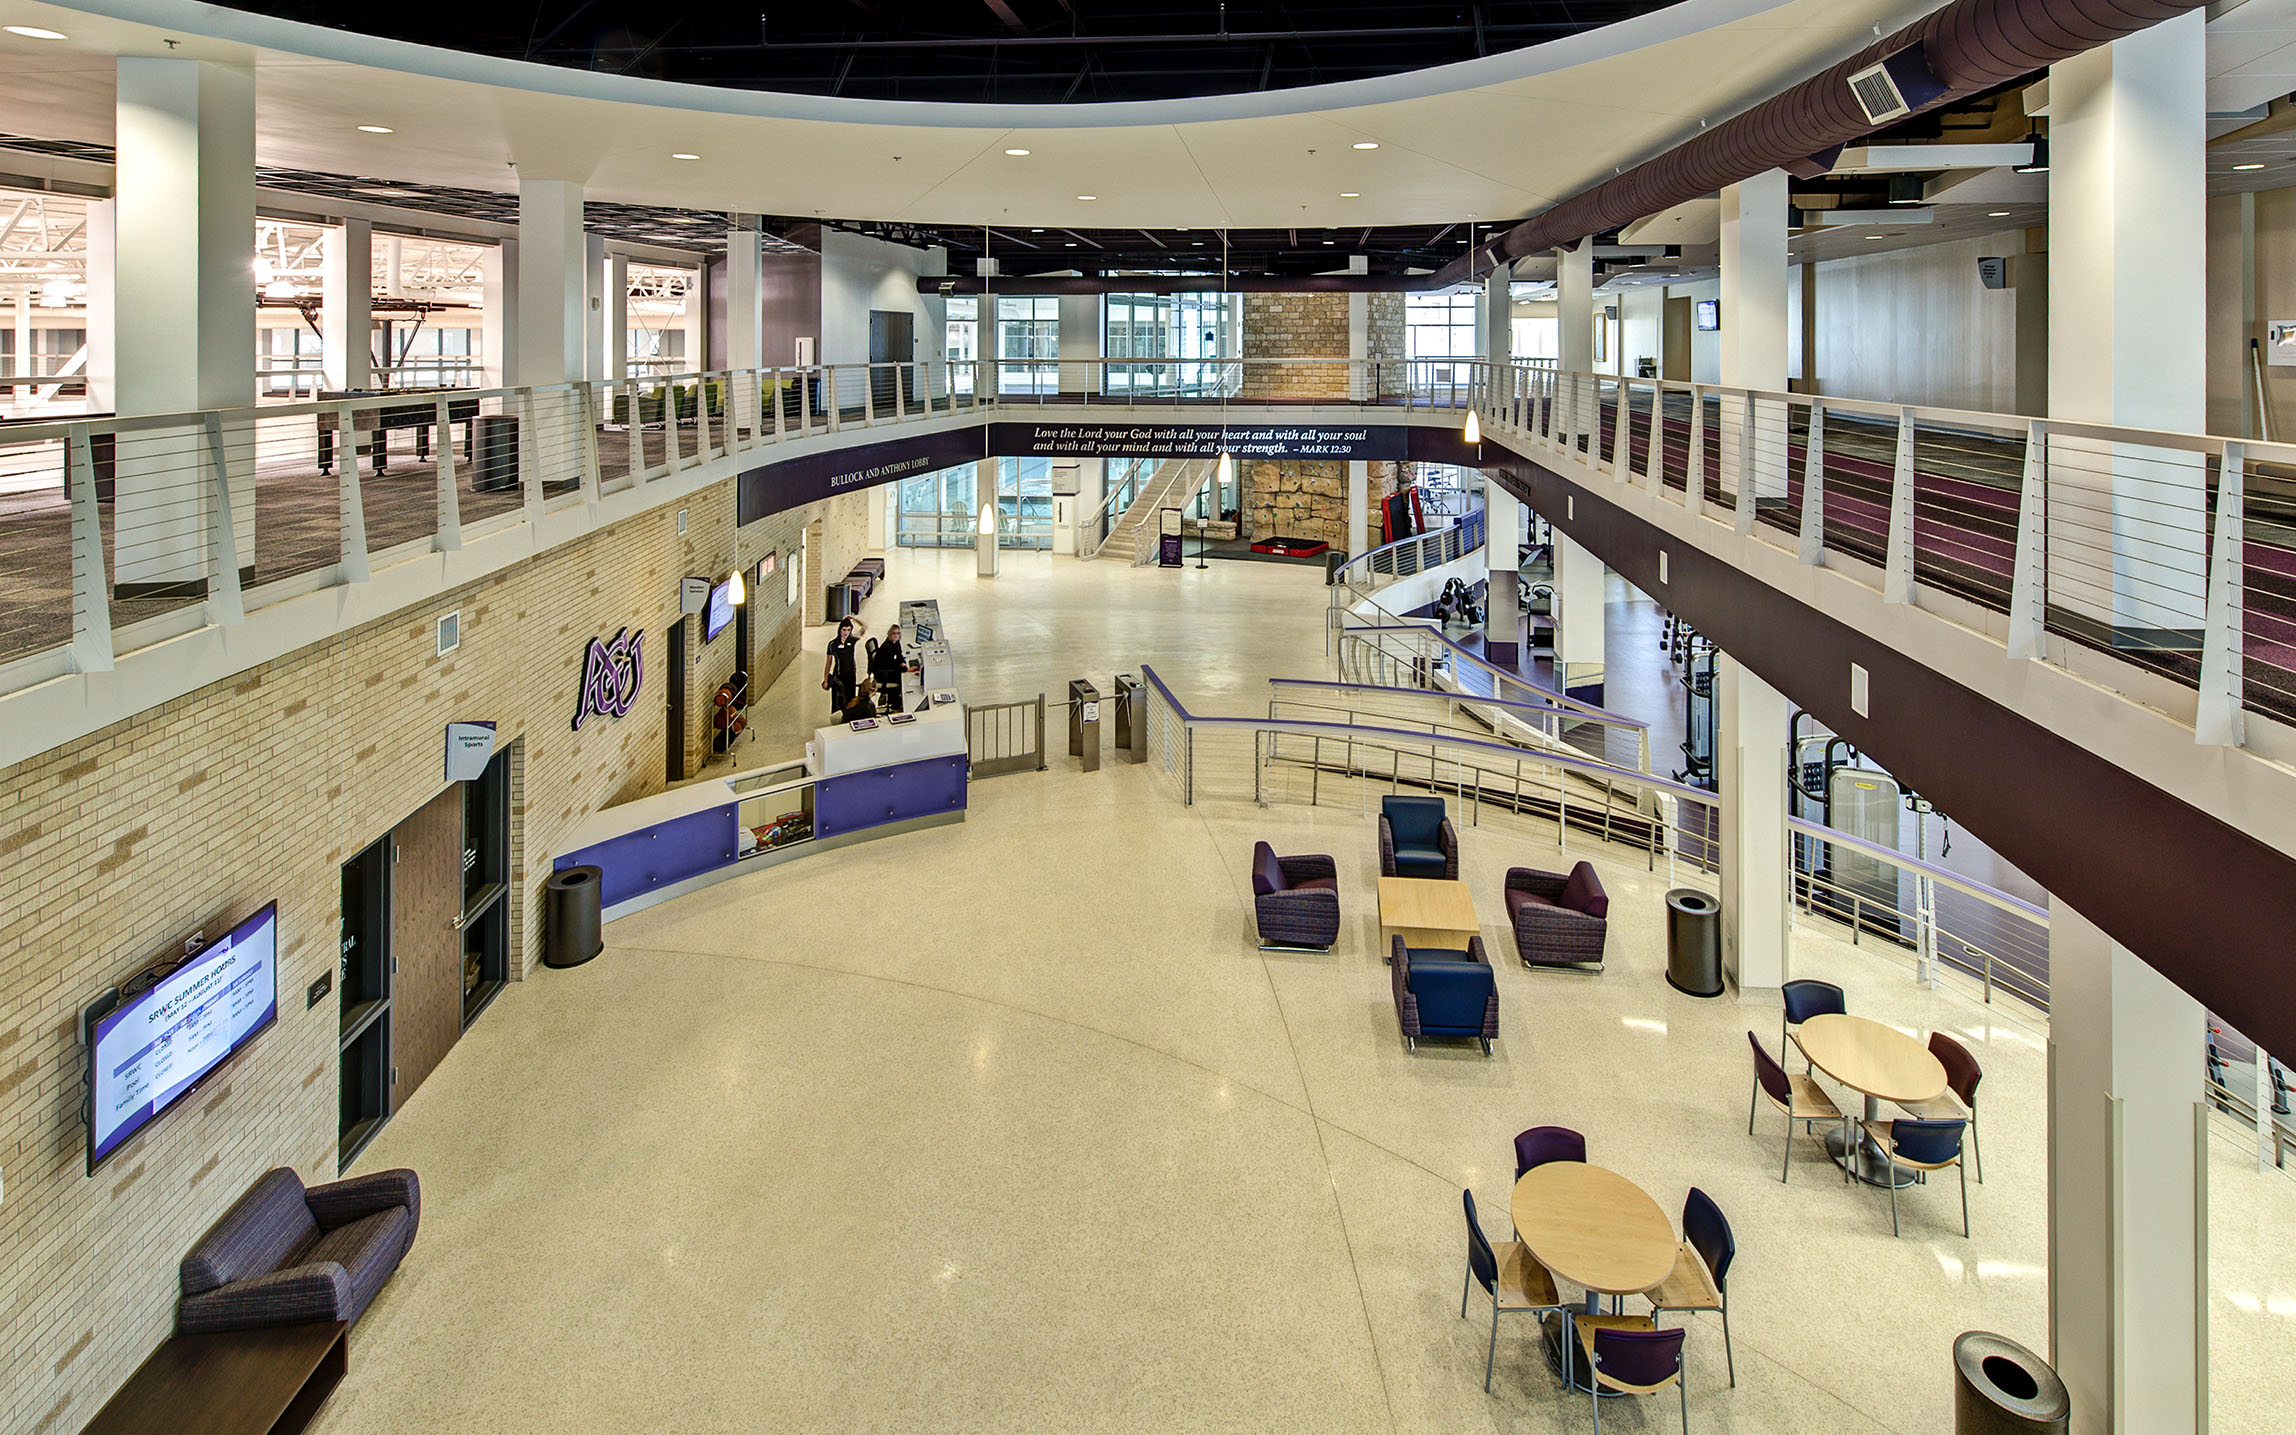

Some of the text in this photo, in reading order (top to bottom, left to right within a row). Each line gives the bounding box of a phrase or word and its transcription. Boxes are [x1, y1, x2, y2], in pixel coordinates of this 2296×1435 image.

[1034, 427, 1367, 443] Love the Lord your God with all your heart and with all your soul
[1033, 440, 1055, 451] and
[1056, 440, 1079, 451] with
[1080, 440, 1096, 451] all
[1096, 443, 1121, 454] your
[1122, 441, 1150, 452] mind
[1151, 441, 1173, 452] and
[1175, 442, 1198, 453] with
[1200, 442, 1215, 453] all
[1215, 444, 1241, 455] your
[1241, 442, 1288, 456] strength.
[1300, 445, 1330, 454] MARK
[1330, 445, 1352, 454] 12:30
[830, 456, 930, 488] BULLOCK AND ANTHONY LOBBY
[148, 1000, 173, 1024] SRWC
[174, 974, 210, 1006] SUMMER
[211, 955, 236, 978] HOURS
